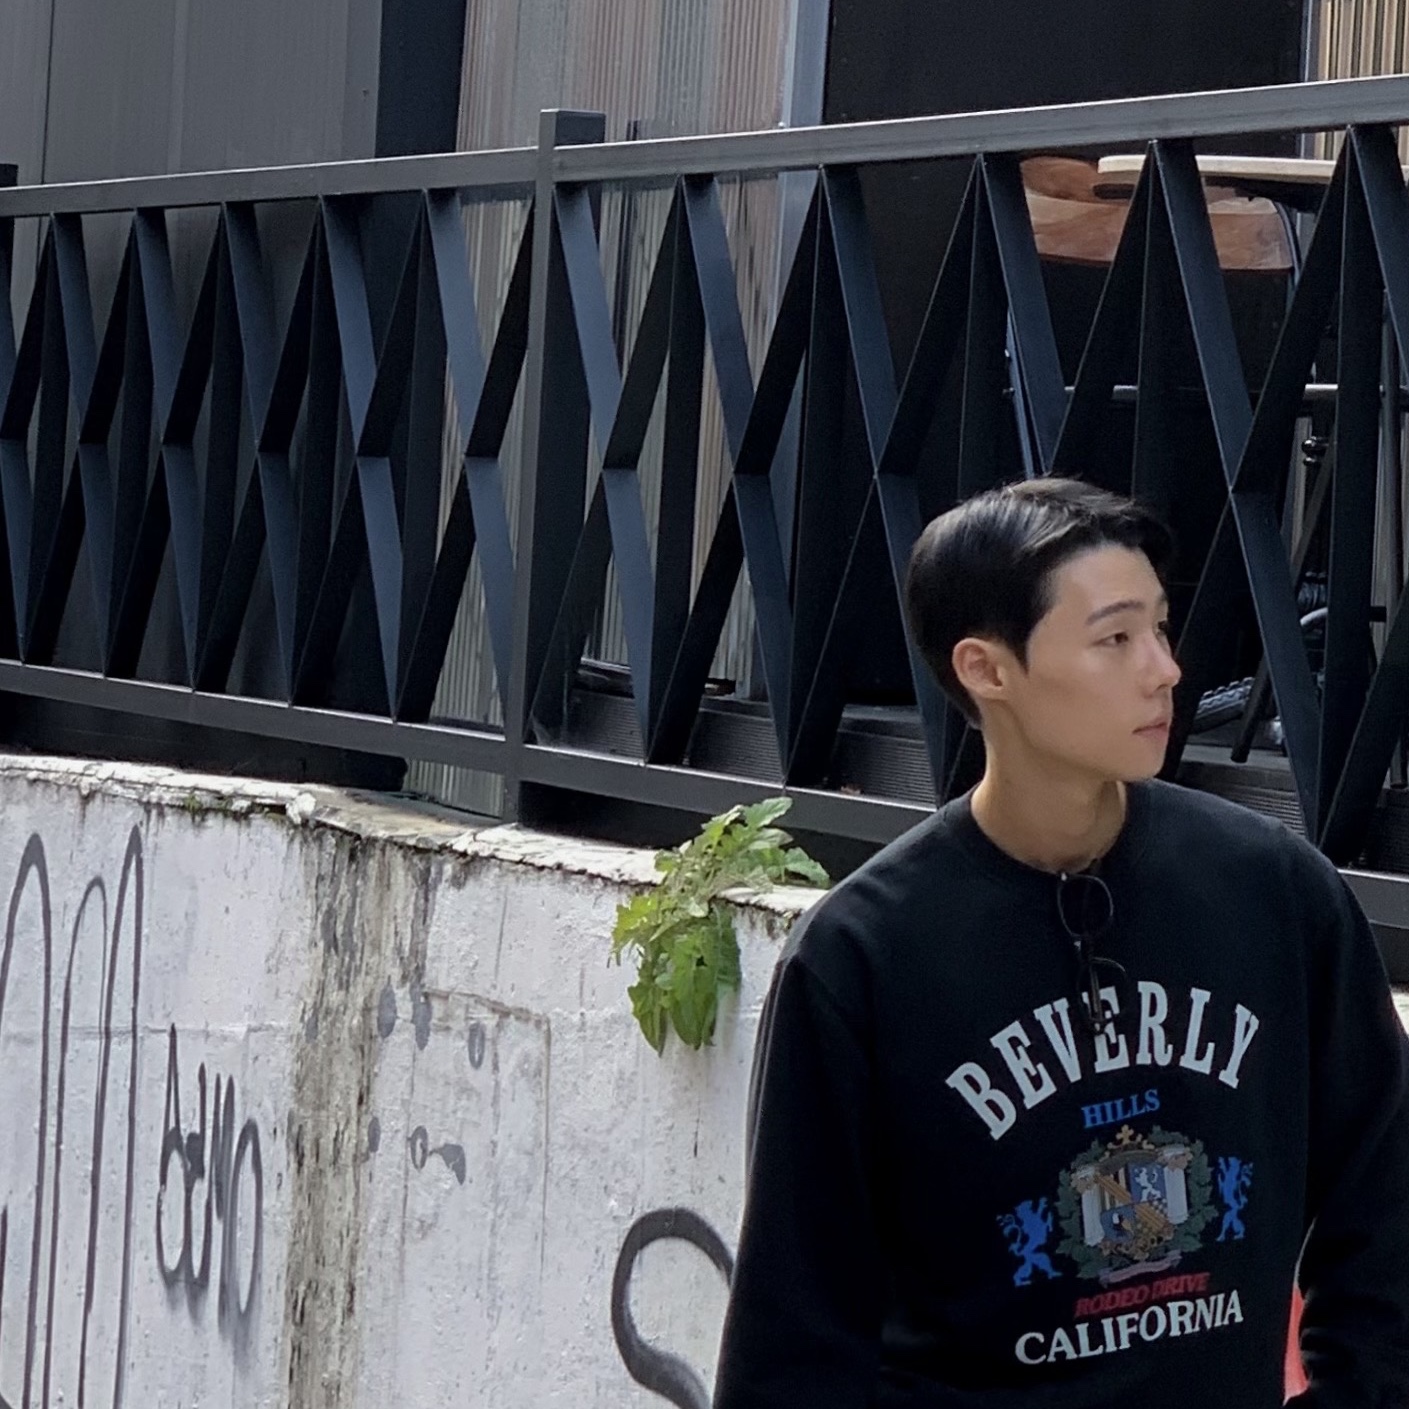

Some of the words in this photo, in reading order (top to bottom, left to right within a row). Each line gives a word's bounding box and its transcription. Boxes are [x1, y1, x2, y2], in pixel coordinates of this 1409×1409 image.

[945, 980, 1260, 1141] BEVERLY
[1080, 1088, 1161, 1129] HILLS
[1074, 1285, 1149, 1318] RODEO
[1151, 1272, 1211, 1300] DRIVE
[1015, 1289, 1243, 1365] CALIFORNIA
